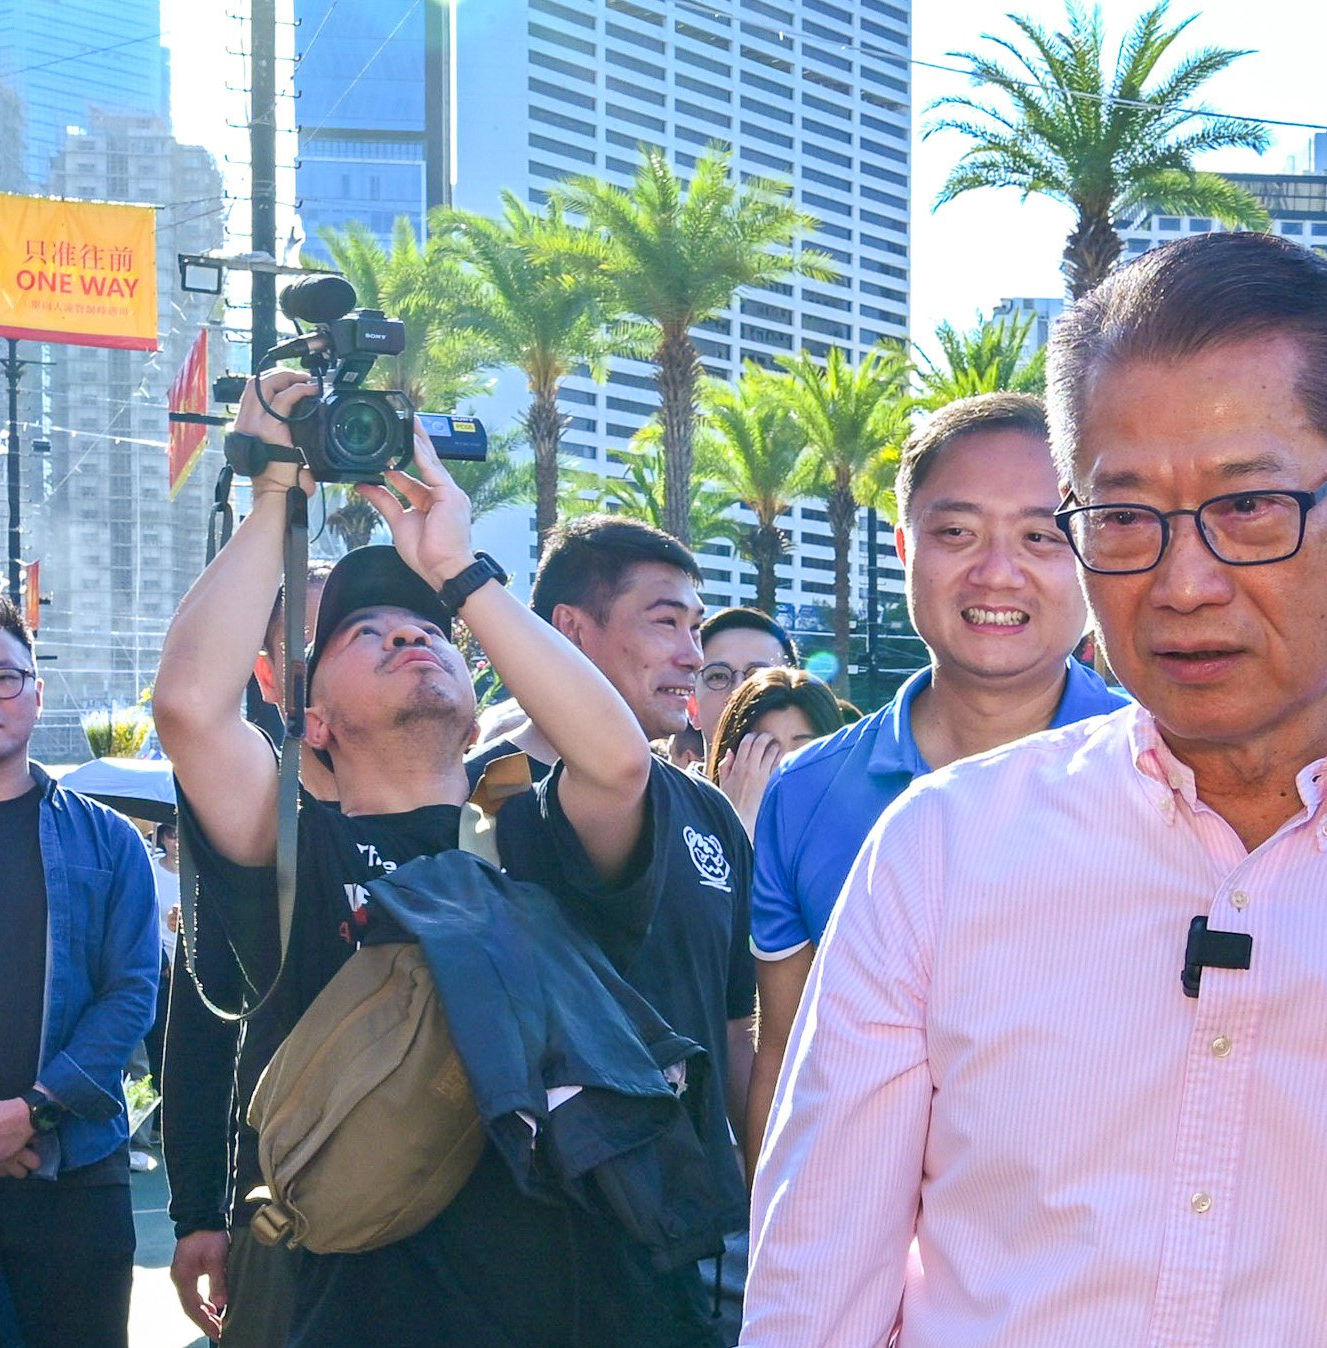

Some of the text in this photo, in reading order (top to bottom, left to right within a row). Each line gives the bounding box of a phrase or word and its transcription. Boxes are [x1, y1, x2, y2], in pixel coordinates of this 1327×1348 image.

[22, 239, 134, 272] 只准往前
[16, 270, 140, 299] ONE WAY
[364, 332, 386, 340] SONY
